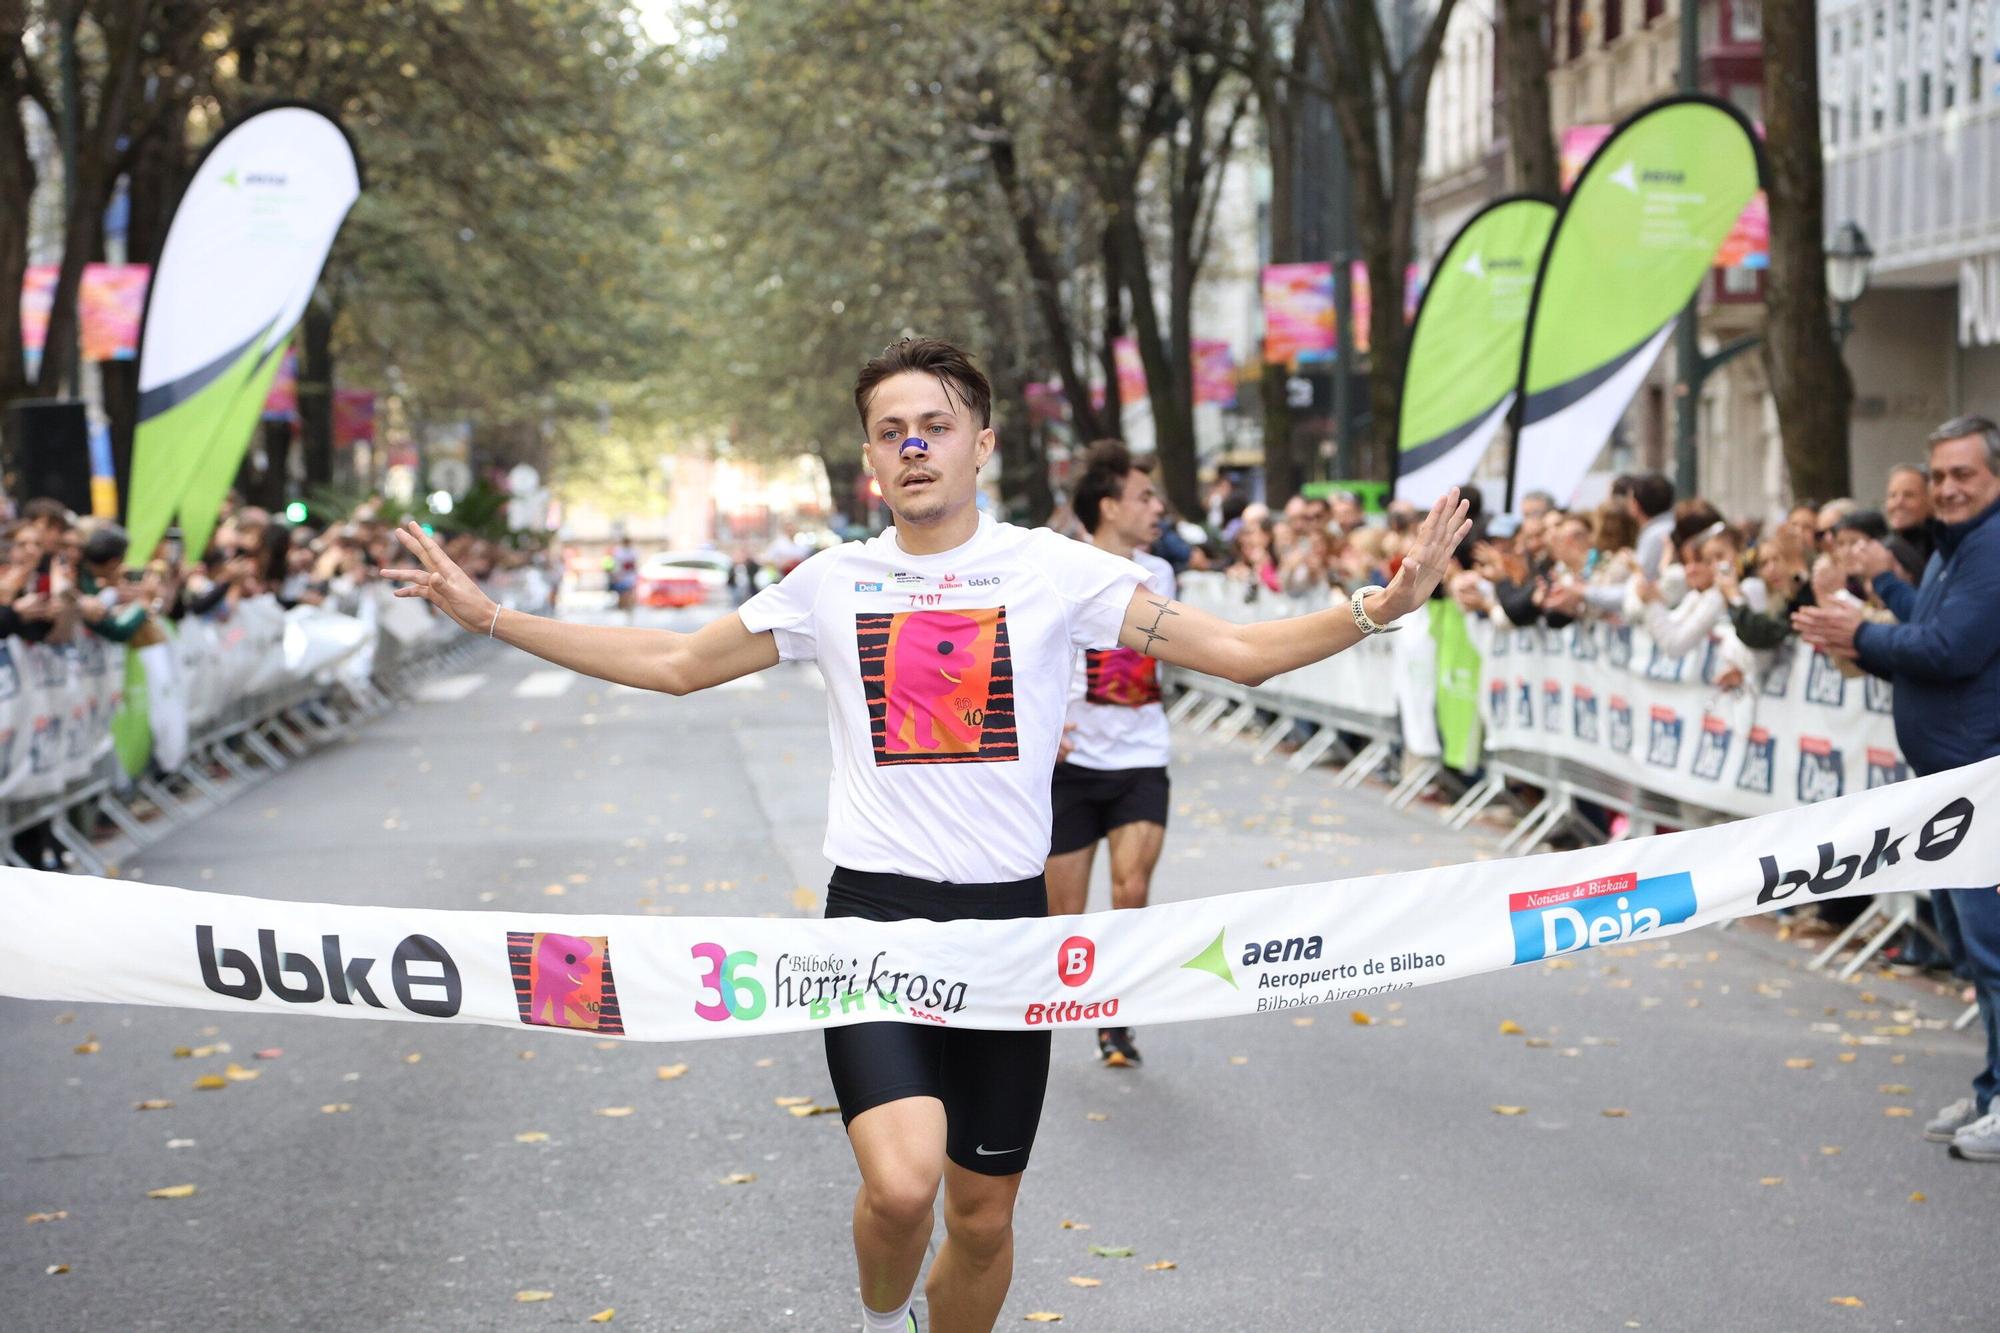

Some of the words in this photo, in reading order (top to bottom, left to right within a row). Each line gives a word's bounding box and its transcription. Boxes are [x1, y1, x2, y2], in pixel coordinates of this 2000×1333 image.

[909, 594, 942, 606] 7107
[964, 708, 984, 726] 10
[1757, 827, 1911, 905] bbk
[1526, 890, 1570, 908] Noticias
[1572, 886, 1585, 898] de
[1588, 878, 1630, 896] Bizkaia
[1541, 896, 1661, 958] Deia
[789, 953, 843, 974] Bilboko
[1066, 947, 1088, 976] B
[1242, 935, 1323, 966] aena
[196, 924, 388, 1009] bbk
[691, 942, 767, 1021] 36
[1258, 963, 1357, 989] Aeropuerto
[1363, 958, 1385, 976] de
[1391, 951, 1446, 972] Bilbao
[1025, 998, 1119, 1025] Bilbao
[1257, 992, 1319, 1012] Bilboko
